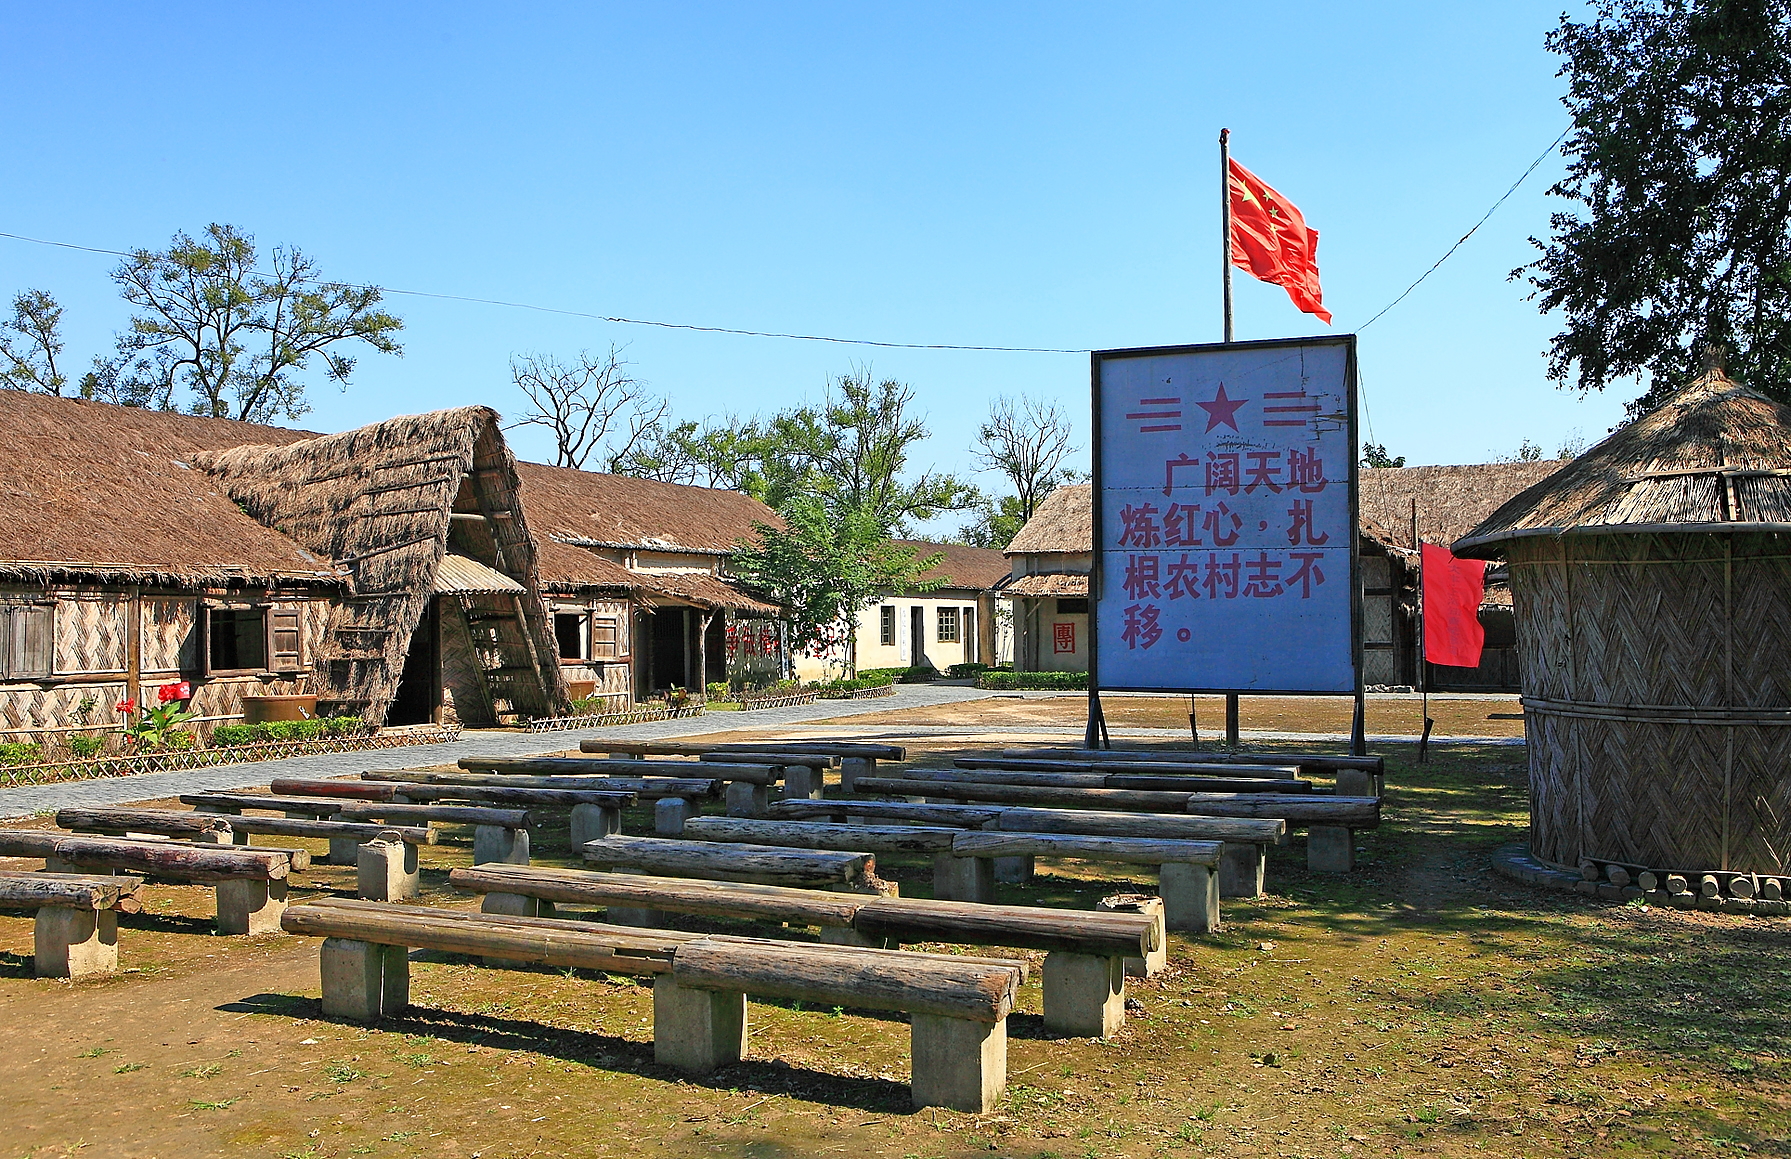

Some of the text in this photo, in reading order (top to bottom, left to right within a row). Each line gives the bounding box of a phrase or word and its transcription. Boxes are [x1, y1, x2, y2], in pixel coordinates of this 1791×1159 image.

[1162, 447, 1327, 498] 广阔天地
[1118, 498, 1329, 549] 炼红心，扎
[1122, 552, 1325, 600] 根农村志不
[1121, 603, 1191, 650] 移。
